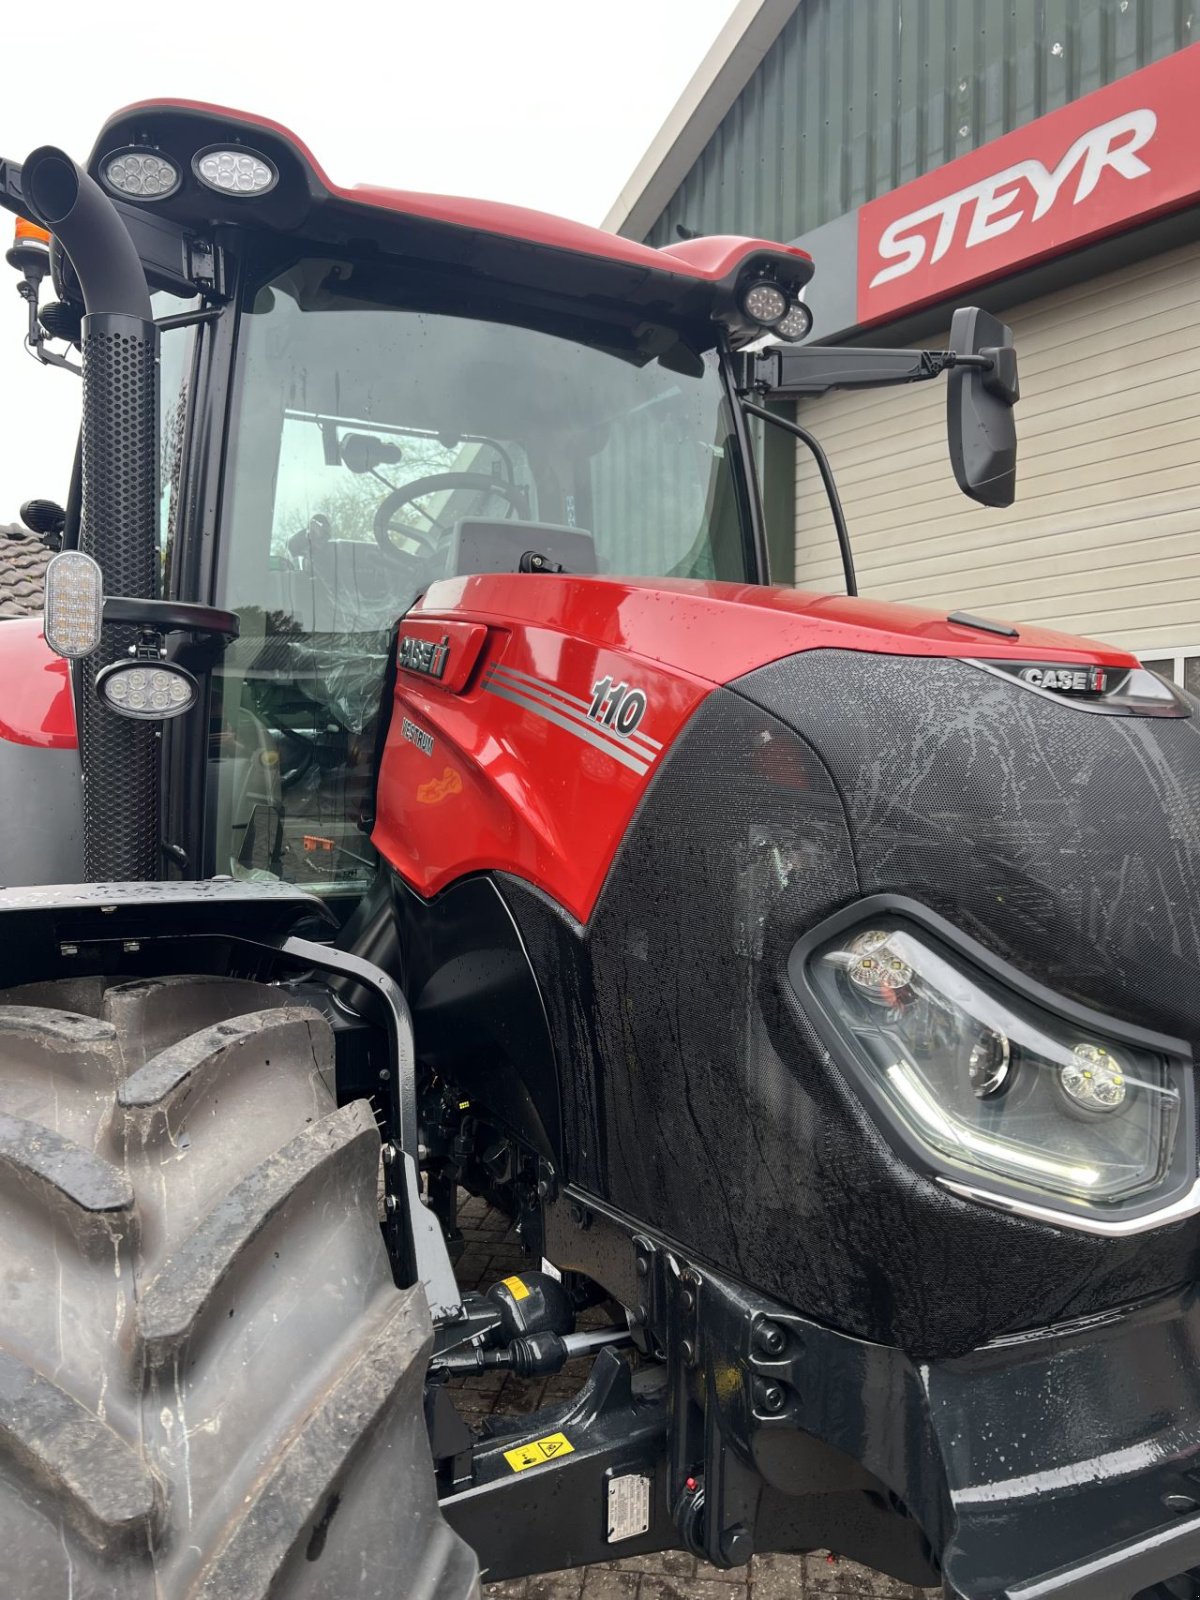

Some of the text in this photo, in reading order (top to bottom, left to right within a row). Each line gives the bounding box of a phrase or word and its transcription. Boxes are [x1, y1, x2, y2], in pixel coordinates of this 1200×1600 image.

[869, 108, 1157, 289] STEYR
[587, 675, 647, 738] 110
[1019, 667, 1088, 690] CASE
